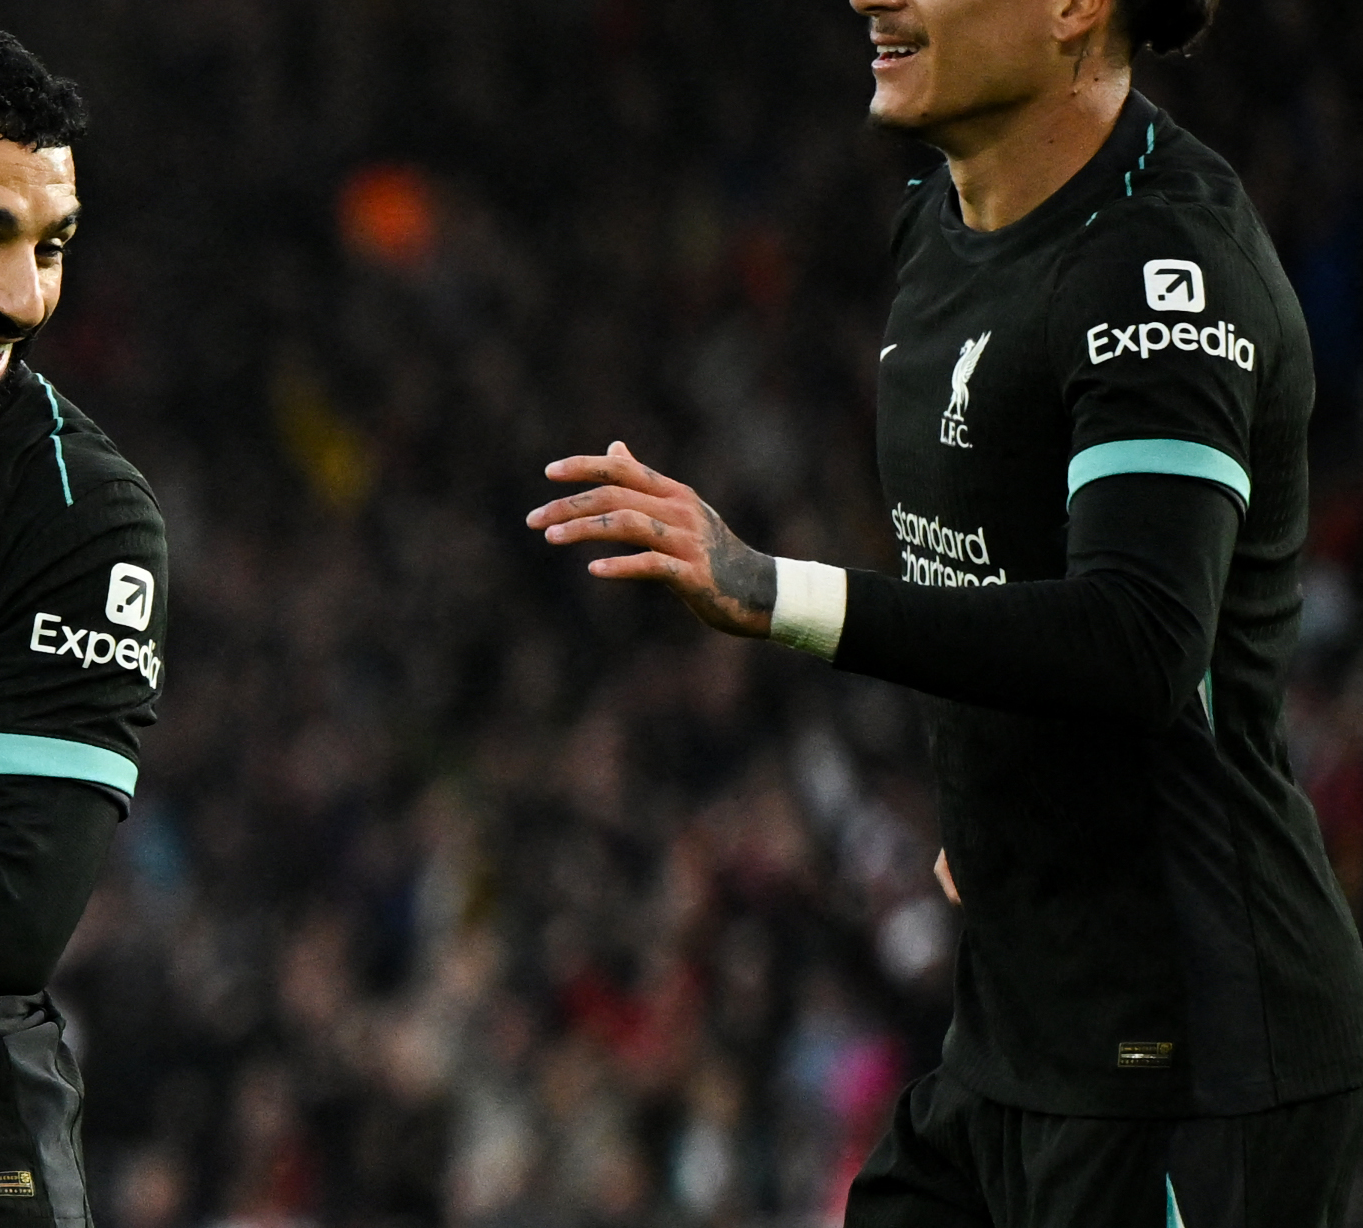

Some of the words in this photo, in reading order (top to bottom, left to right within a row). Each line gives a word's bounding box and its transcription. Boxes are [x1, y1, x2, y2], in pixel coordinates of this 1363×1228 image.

[1087, 321, 1254, 371] Expedia
[891, 501, 991, 566] standard
[29, 612, 162, 690] Expedia
